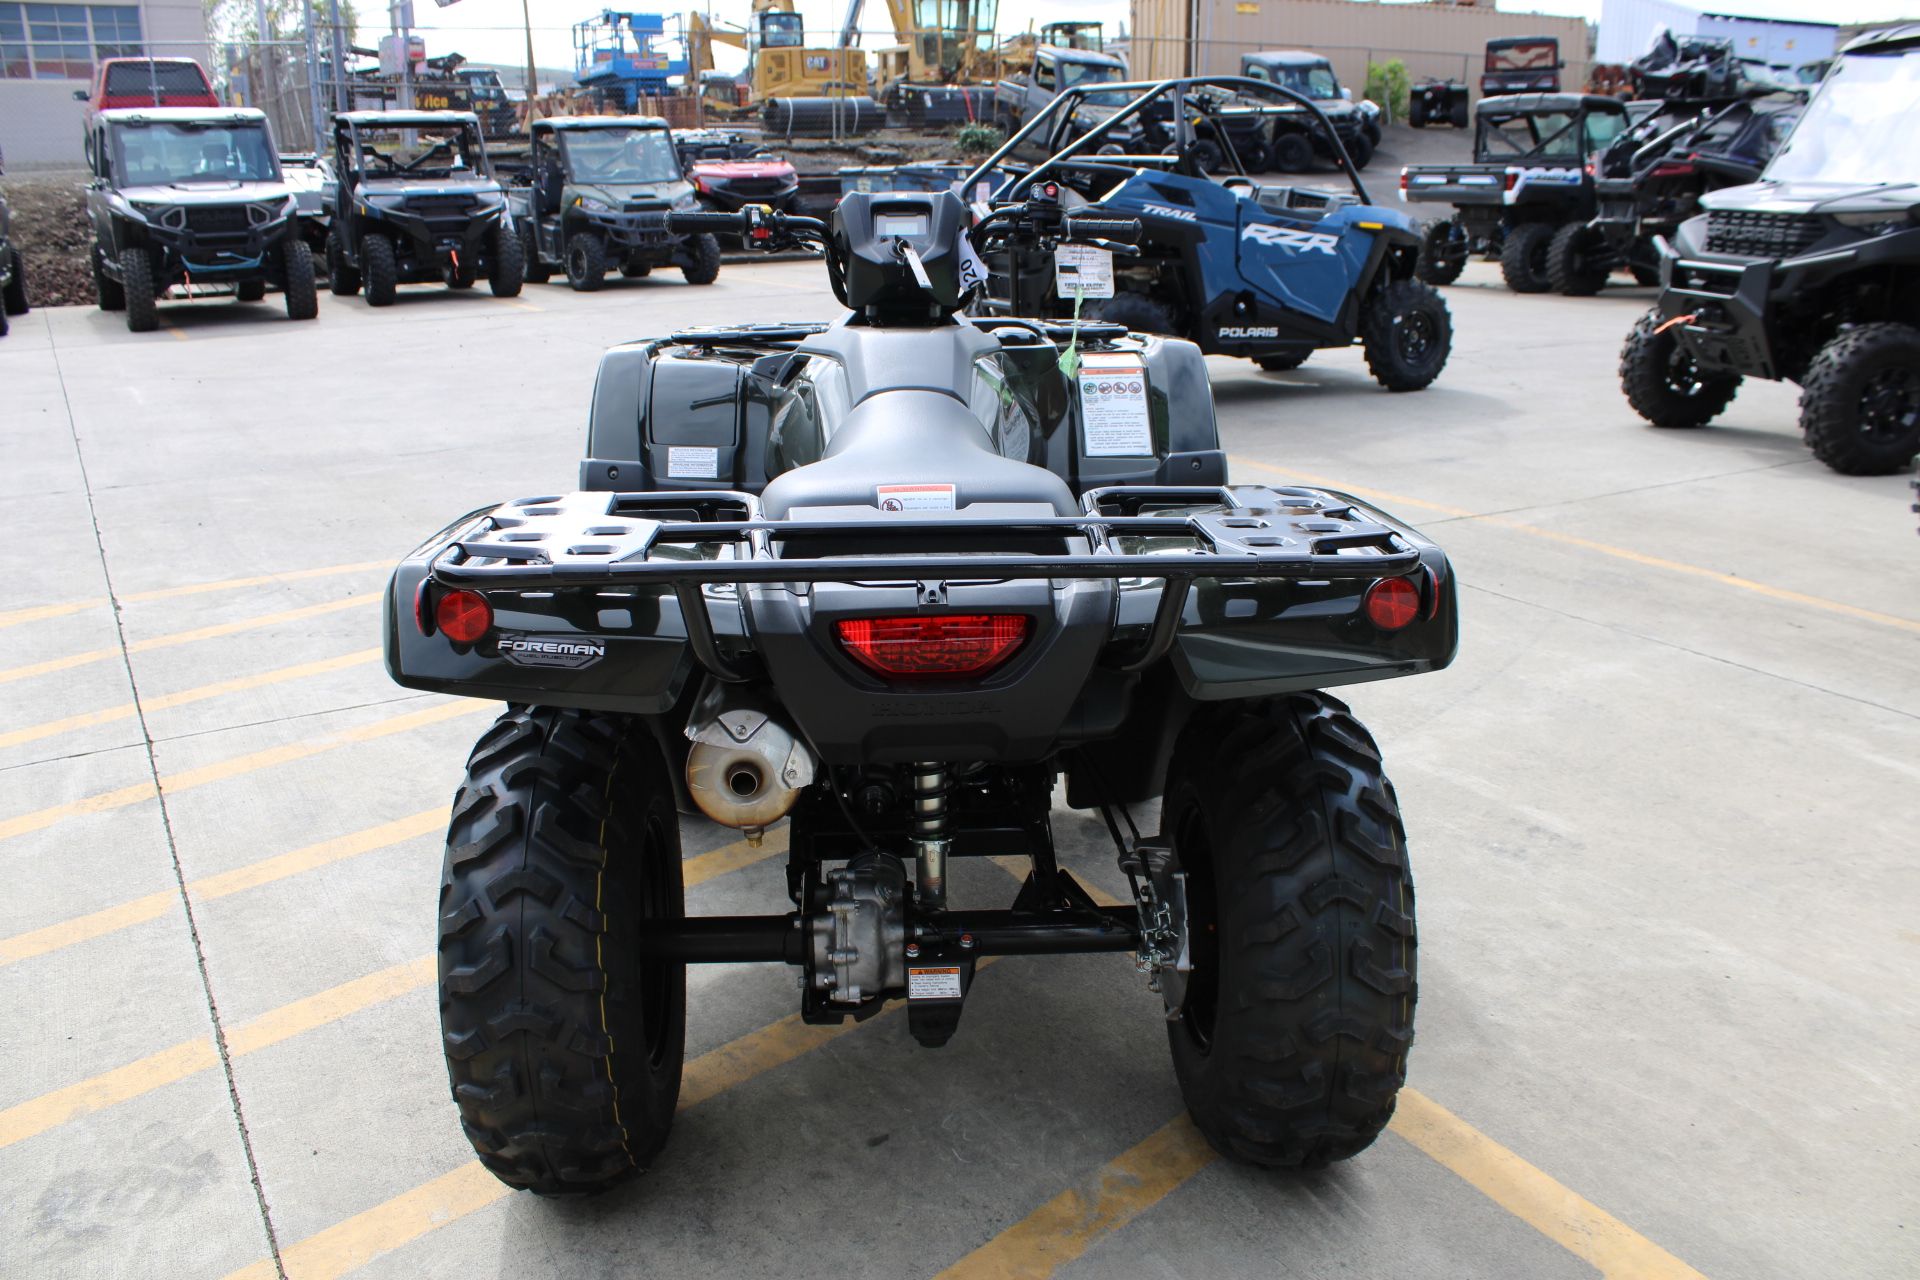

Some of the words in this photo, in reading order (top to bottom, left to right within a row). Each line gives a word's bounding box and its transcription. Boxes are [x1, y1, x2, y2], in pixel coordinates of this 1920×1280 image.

[806, 55, 825, 71] CAT
[1142, 204, 1197, 221] TRAIL
[1241, 223, 1340, 256] RZR
[1711, 225, 1785, 242] POLARIS
[1218, 327, 1279, 338] POLARIS
[497, 640, 605, 656] FOREMAN
